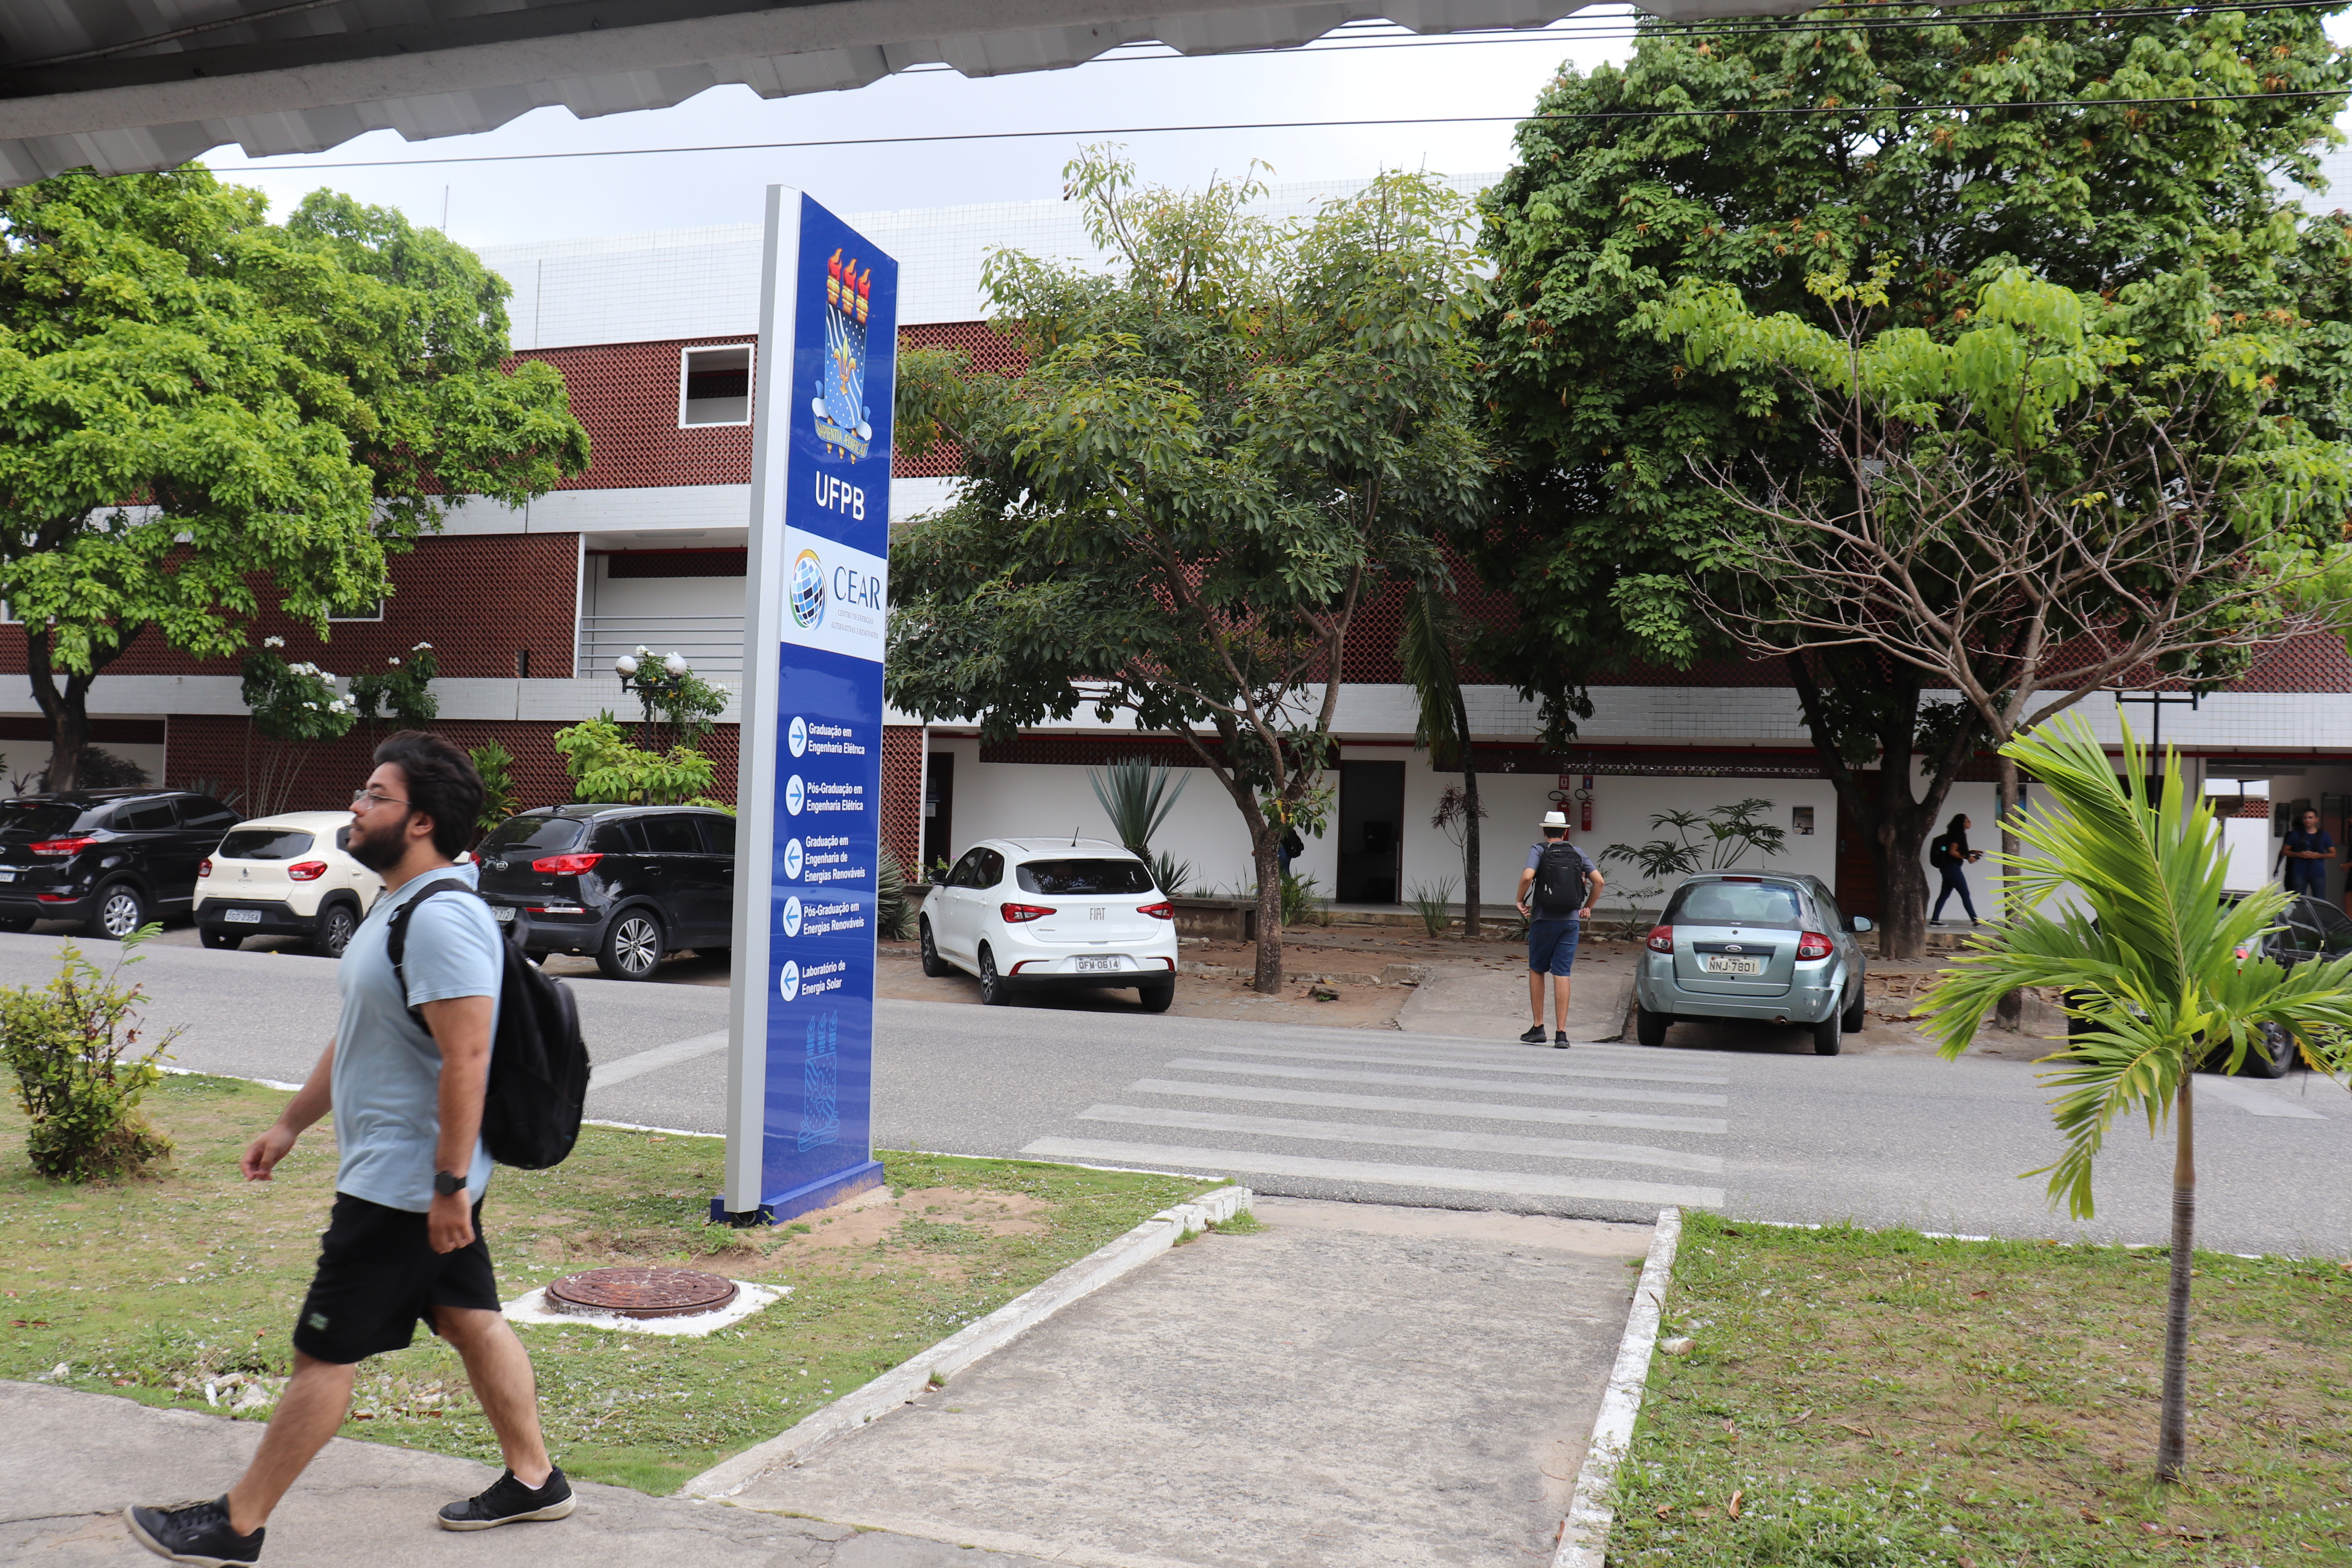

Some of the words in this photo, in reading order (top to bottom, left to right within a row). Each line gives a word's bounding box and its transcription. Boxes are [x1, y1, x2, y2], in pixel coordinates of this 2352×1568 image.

[815, 419, 842, 444] SAPIENTIA
[815, 470, 865, 521] UFPB
[834, 566, 880, 610] CEAR
[838, 609, 852, 619] CENTRO
[857, 615, 873, 624] ENERGIAS
[831, 622, 855, 633] ALTERNATIVAS
[809, 722, 842, 739] Graduação
[843, 728, 852, 737] em
[808, 740, 842, 755] Engenharia
[844, 742, 865, 755] Elétrica
[807, 782, 853, 797] Pós-Graduação
[854, 785, 862, 794] em
[807, 800, 840, 814] Engenharia
[842, 799, 863, 811] Elétrica
[806, 835, 838, 849] Graduação
[839, 837, 849, 846] em
[805, 852, 839, 867] Engenharia
[840, 851, 848, 862] de
[805, 869, 831, 884] Energias
[832, 867, 866, 880] Renováveis
[804, 902, 849, 918] Pós-Graduação
[850, 902, 859, 912] em
[1090, 908, 1105, 920] FIAT
[803, 921, 830, 936] Energias
[831, 916, 864, 931] Renováveis
[802, 962, 837, 978] Laboratório
[838, 960, 846, 971] de
[802, 981, 825, 995] Energia
[826, 978, 842, 990] Solar
